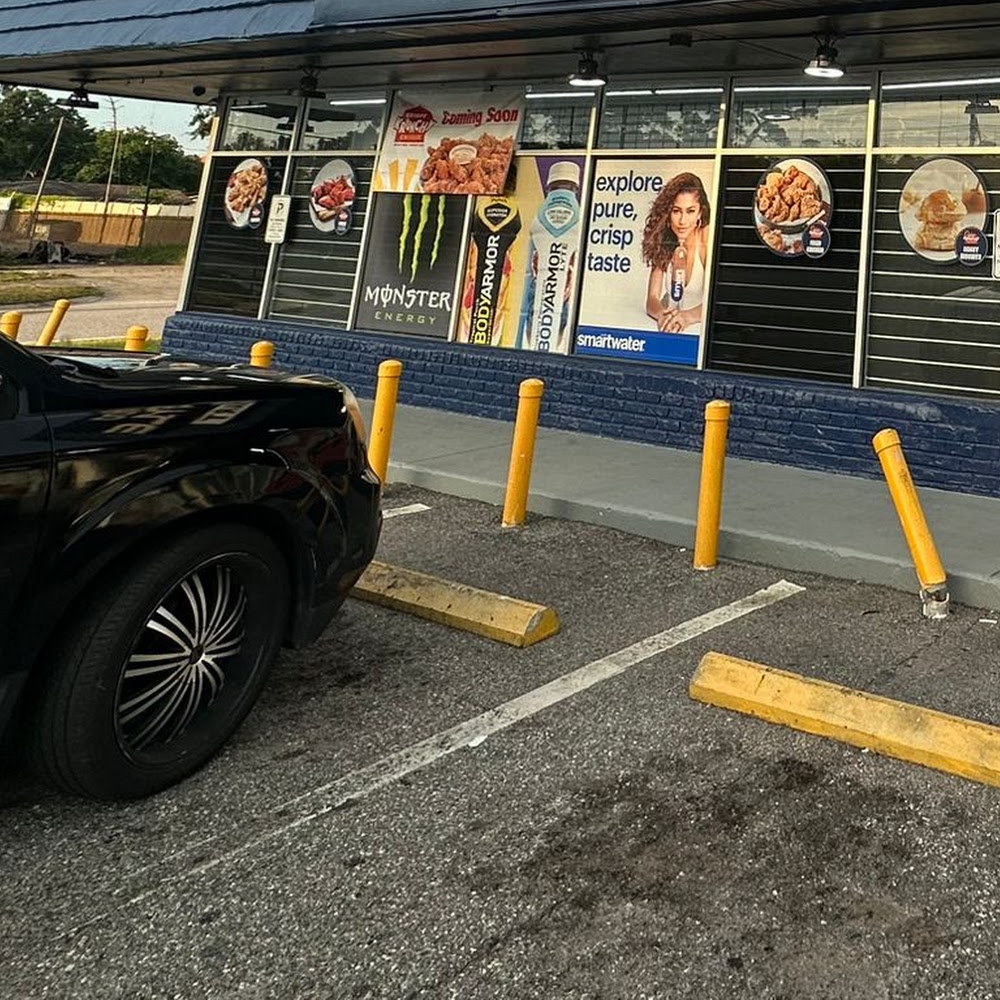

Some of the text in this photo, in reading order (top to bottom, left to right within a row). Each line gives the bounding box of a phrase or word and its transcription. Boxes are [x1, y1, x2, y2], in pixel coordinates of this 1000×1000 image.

[441, 108, 483, 127] Coming
[486, 107, 519, 122] Soon
[596, 170, 663, 196] explore
[592, 201, 638, 222] pure,
[590, 224, 634, 250] crisp
[587, 253, 631, 273] taste
[364, 283, 452, 312] MONSTER
[474, 234, 500, 345] BODYARMOR
[538, 242, 562, 351] BODYARMOR
[374, 311, 437, 325] ENERGY
[576, 333, 646, 352] smartwater
